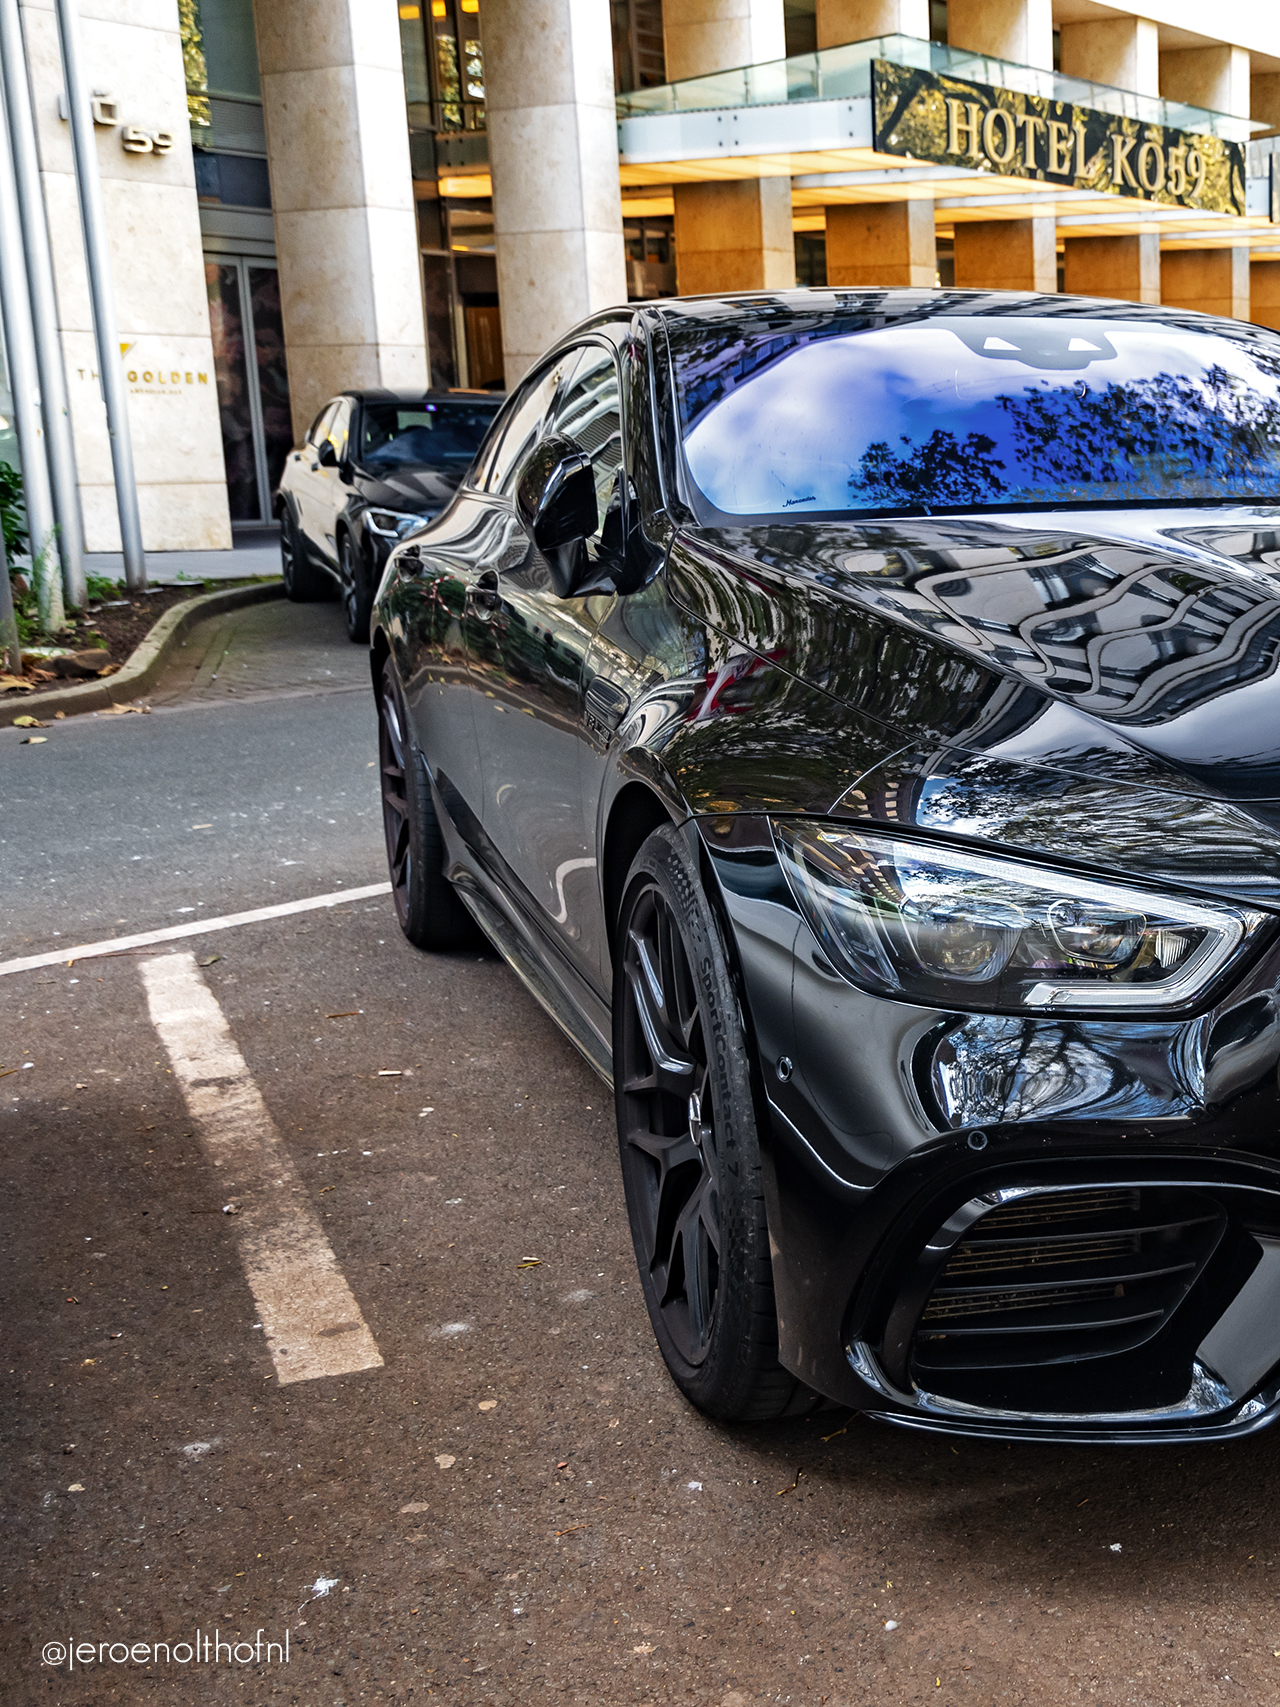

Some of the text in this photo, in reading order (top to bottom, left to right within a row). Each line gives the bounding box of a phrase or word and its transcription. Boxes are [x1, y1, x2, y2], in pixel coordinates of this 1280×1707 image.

[121, 126, 175, 156] 59
[945, 98, 1207, 198] HOTEL KÖ59
[127, 370, 208, 384] GOLDEN
[700, 956, 739, 1177] SportContact 7
